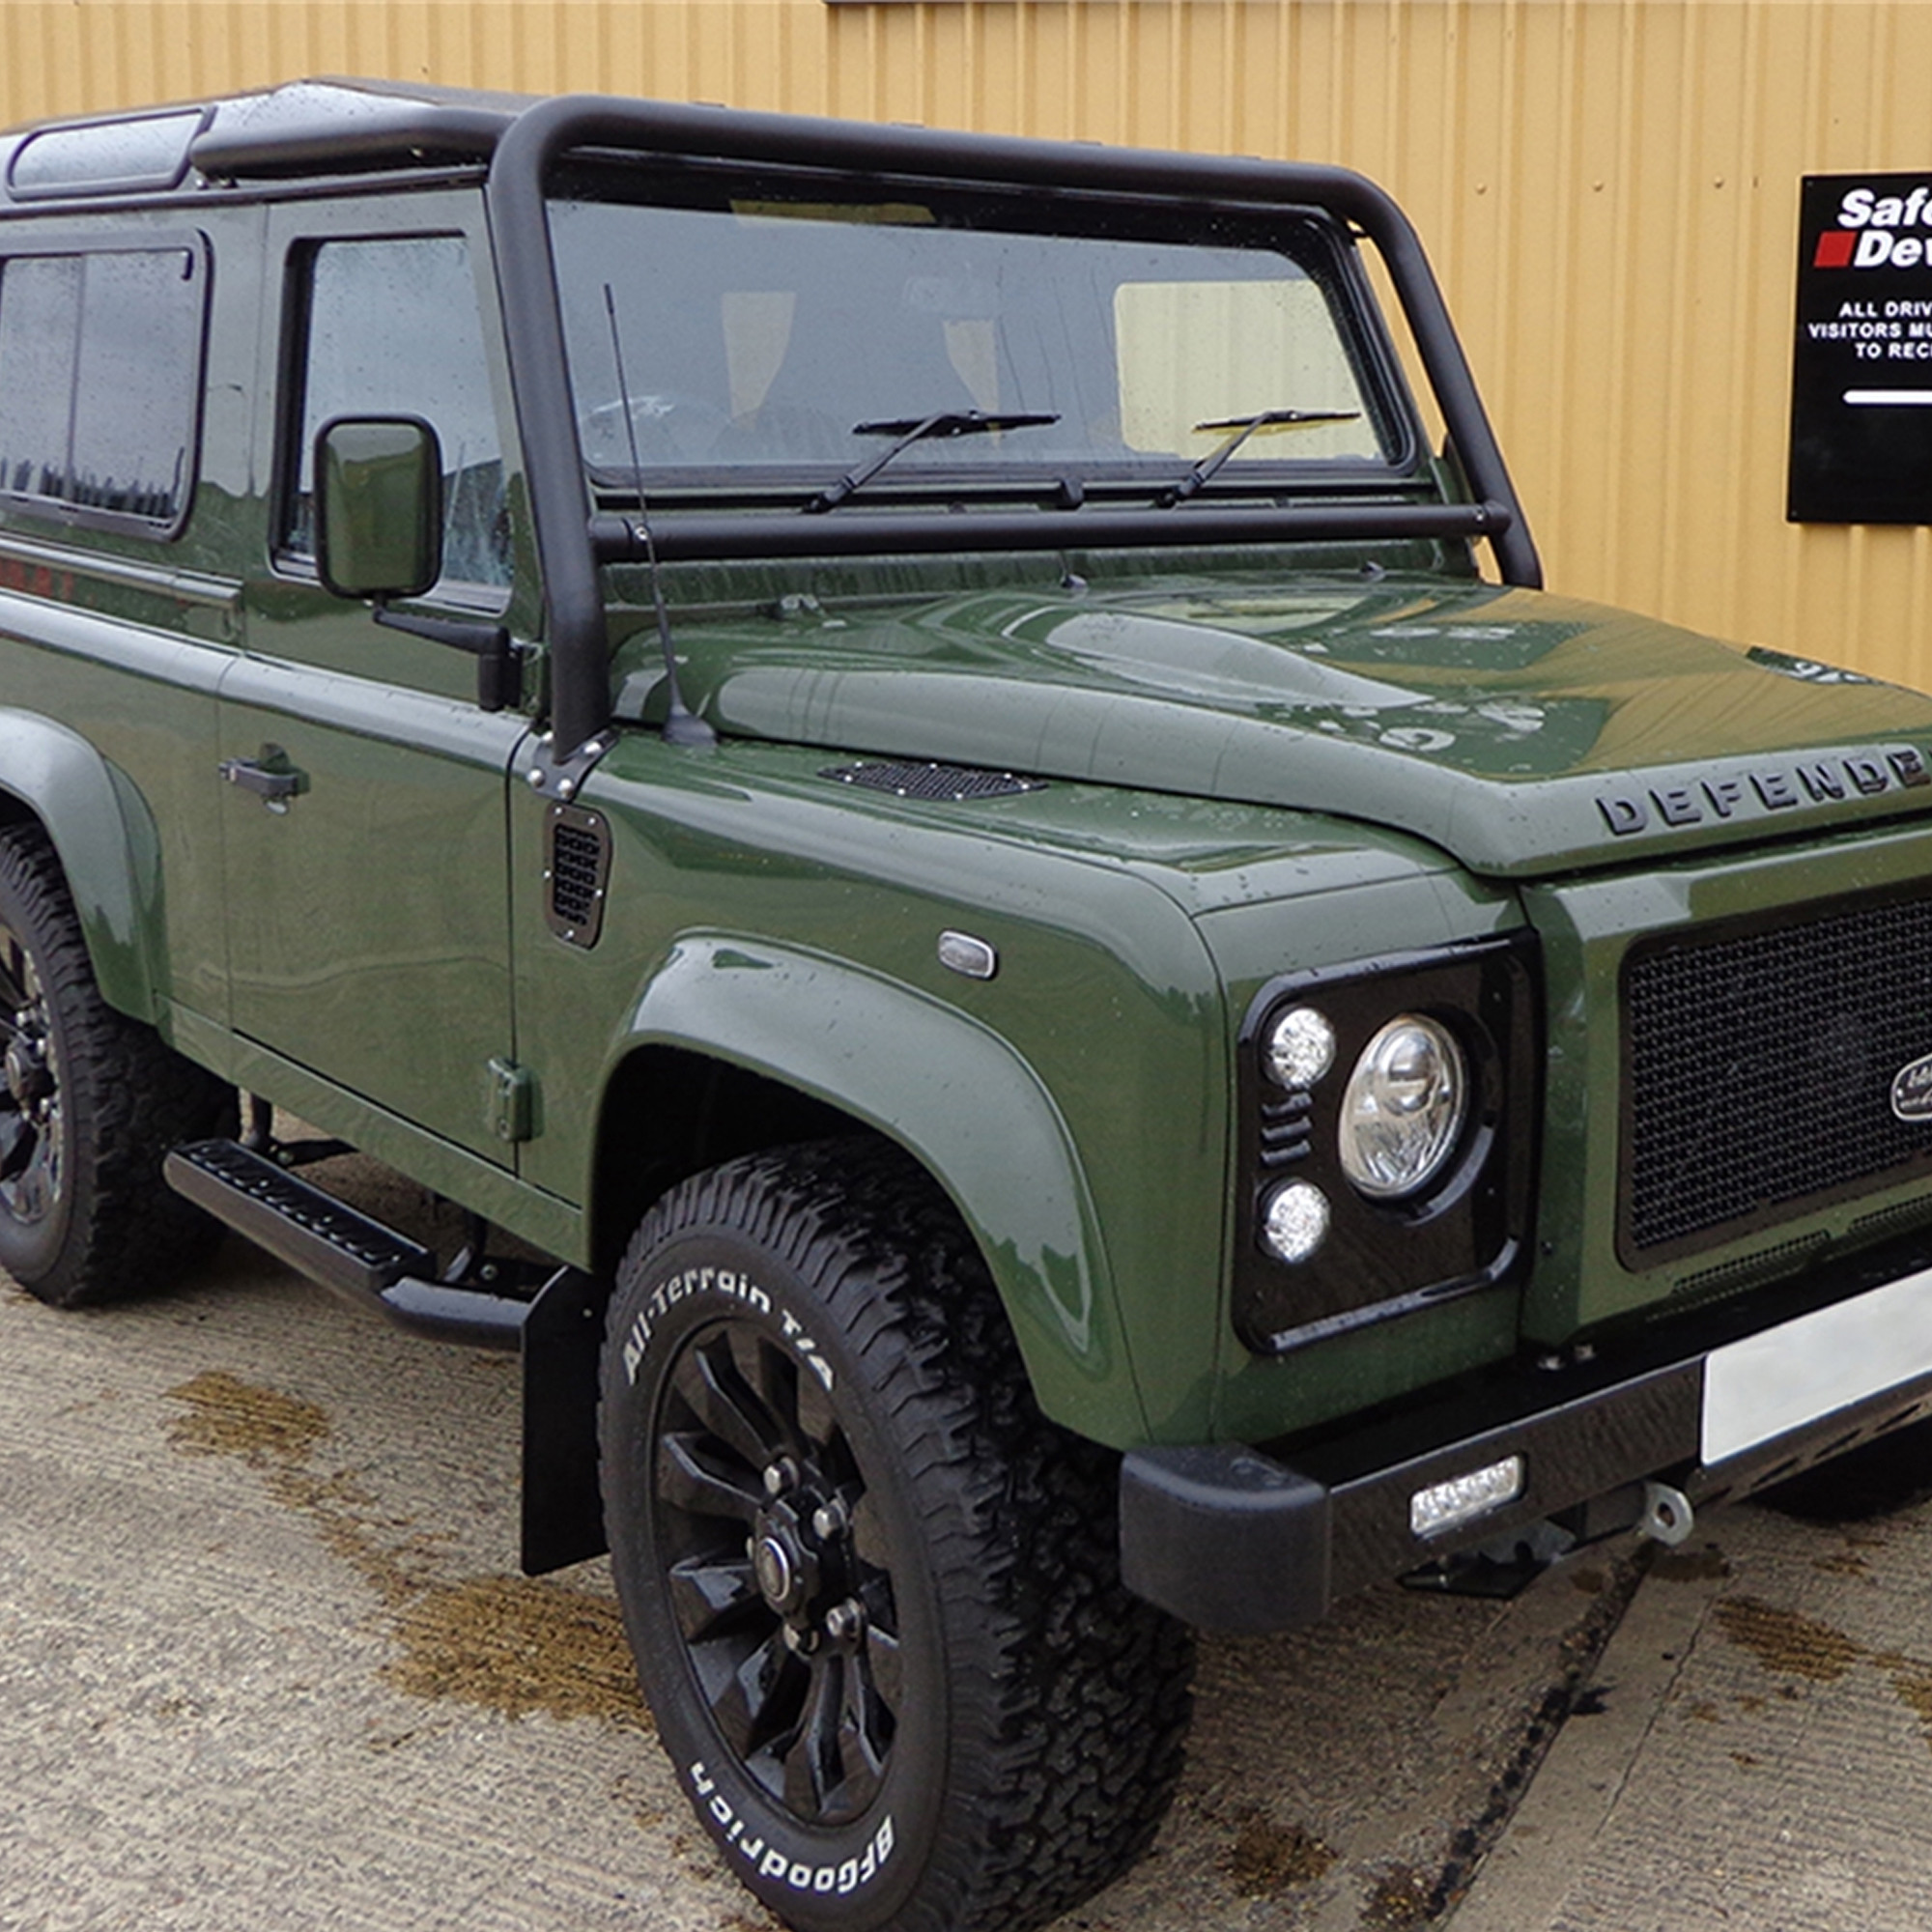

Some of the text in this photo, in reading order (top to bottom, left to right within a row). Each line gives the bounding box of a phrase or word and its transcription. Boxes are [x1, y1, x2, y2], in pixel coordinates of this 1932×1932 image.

[1853, 229, 1932, 268] De
[1838, 300, 1932, 318] ALL DRIV
[1807, 322, 1902, 338] VISITORS
[1855, 341, 1932, 358] TO REC
[1595, 749, 1932, 837] DEFENDE
[690, 1761, 895, 1894] BFGoodrich
